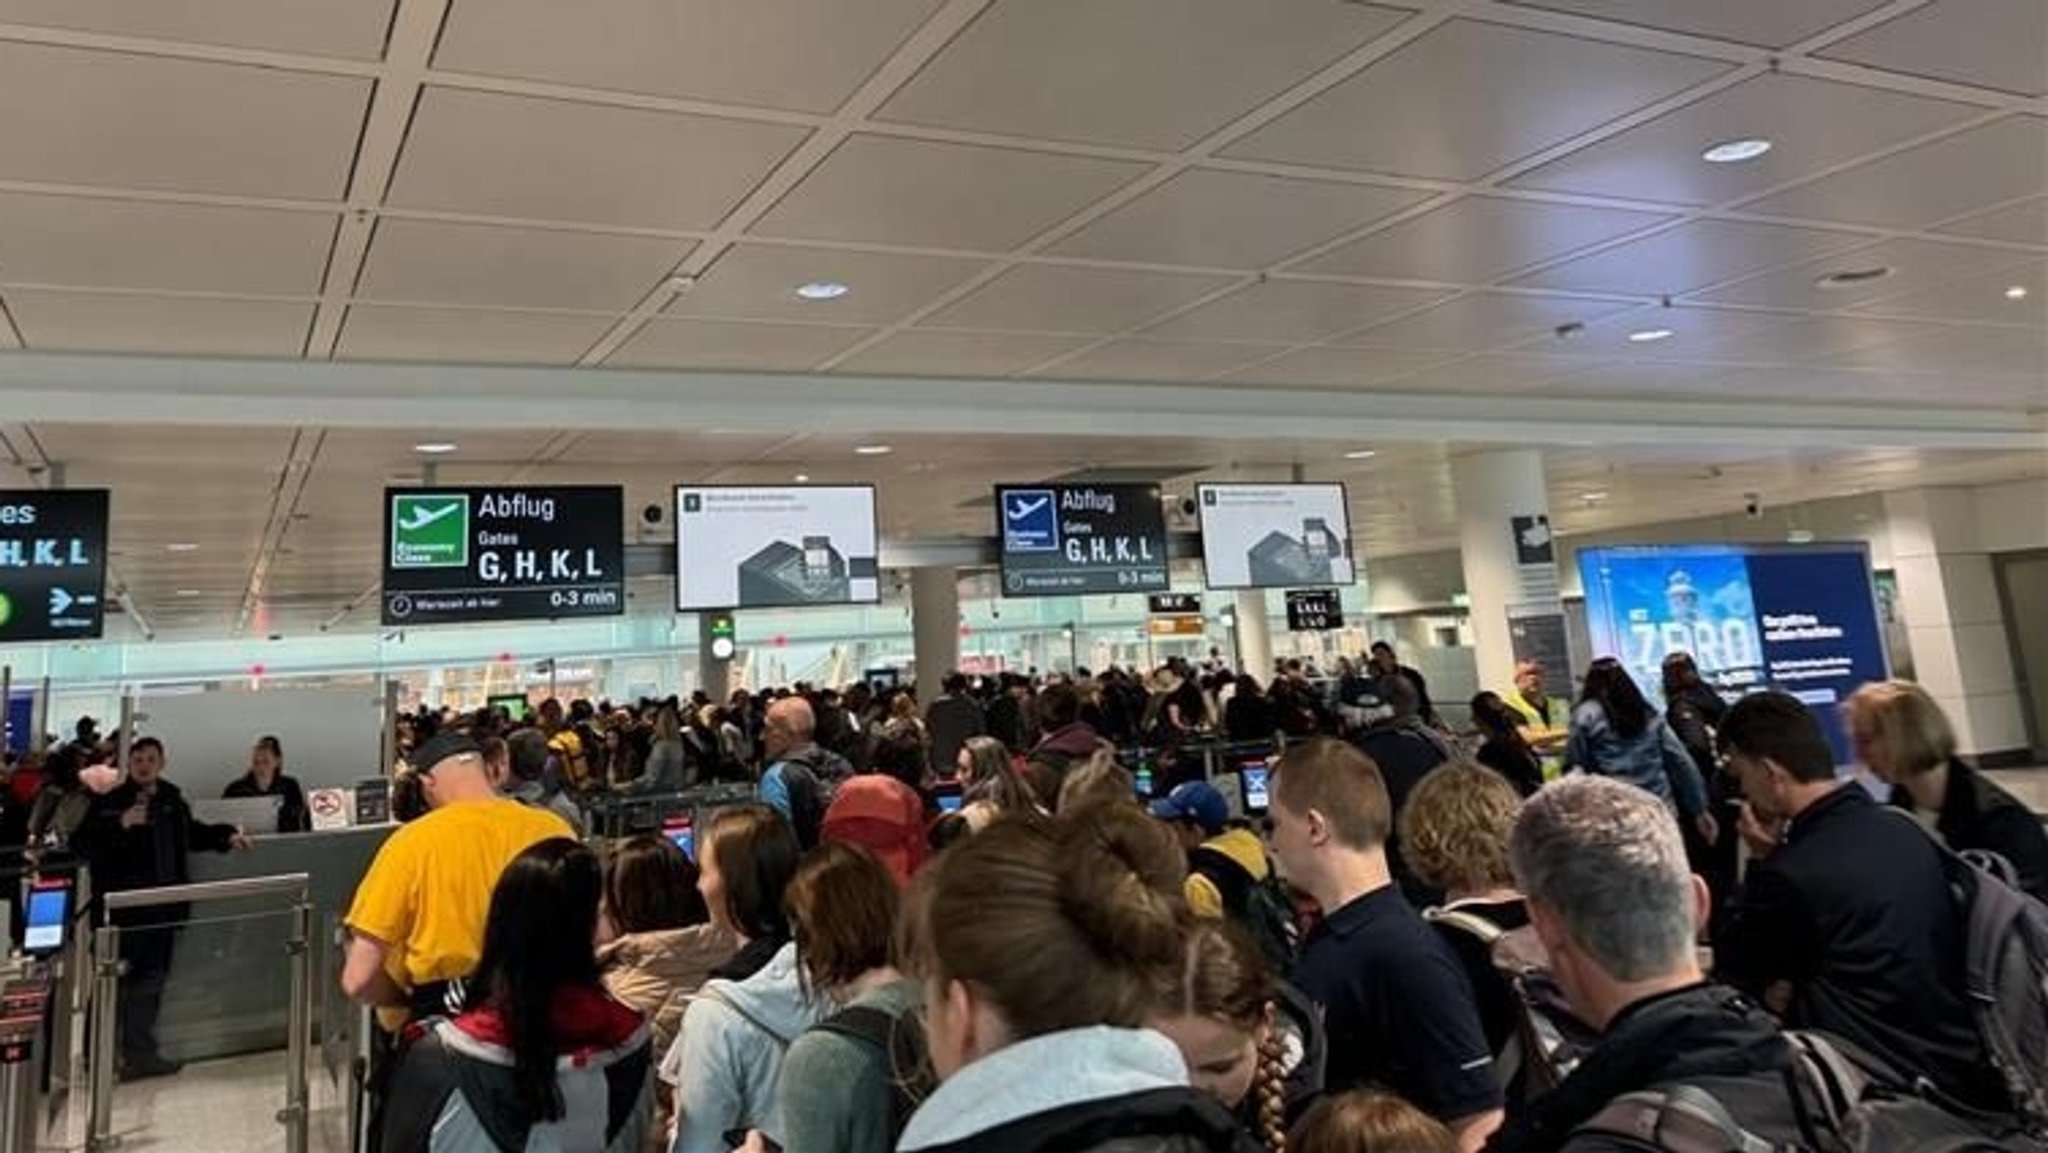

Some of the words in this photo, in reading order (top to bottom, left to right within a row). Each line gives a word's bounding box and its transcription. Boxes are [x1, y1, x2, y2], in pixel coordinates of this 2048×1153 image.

[478, 494, 554, 520] Abflug
[1062, 490, 1115, 513] Abflug
[478, 531, 518, 546] Gates
[1066, 537, 1087, 564] G,
[1090, 537, 1111, 563] H,
[1115, 536, 1137, 563] K,
[1139, 536, 1153, 560] L
[70, 539, 89, 564] L
[478, 552, 508, 583] G,
[515, 551, 544, 582] H,
[551, 549, 579, 580] K,
[586, 548, 602, 576] L
[551, 590, 579, 607] 0-3
[583, 590, 617, 606] min
